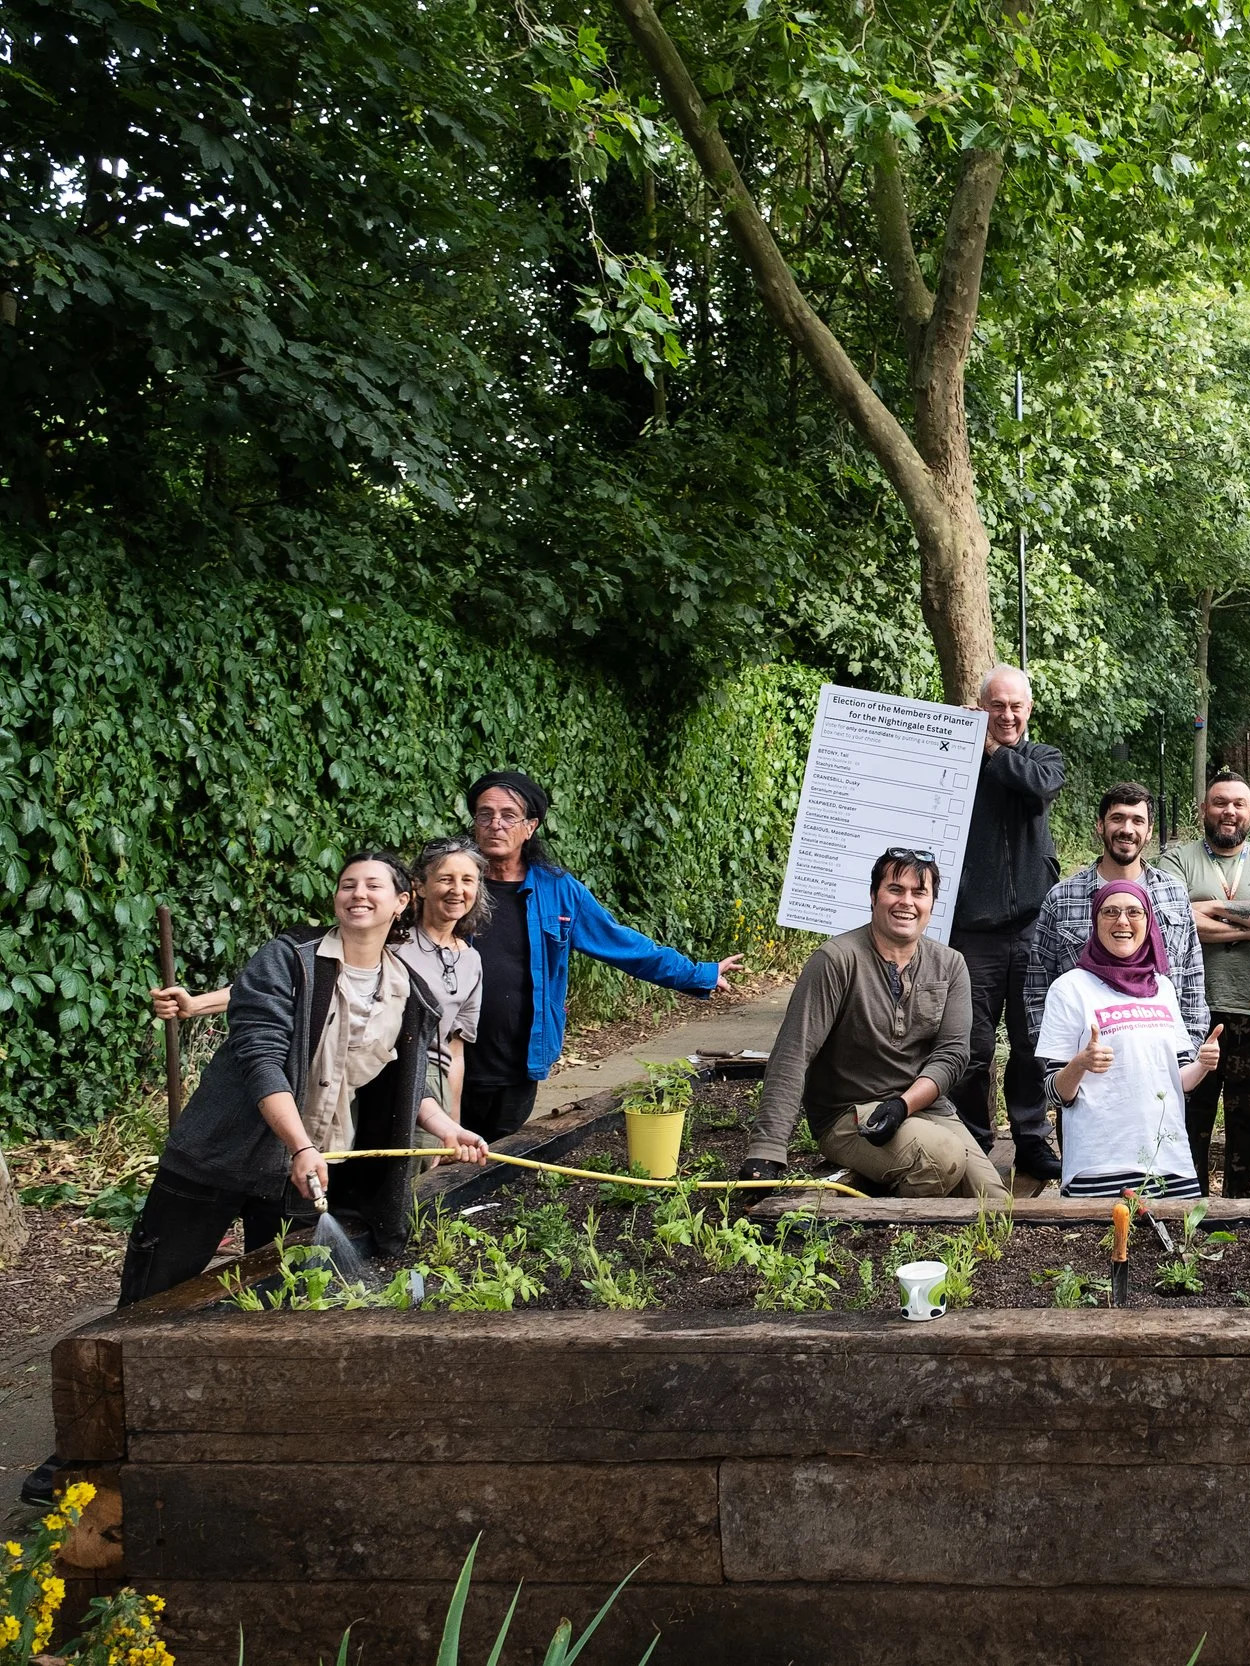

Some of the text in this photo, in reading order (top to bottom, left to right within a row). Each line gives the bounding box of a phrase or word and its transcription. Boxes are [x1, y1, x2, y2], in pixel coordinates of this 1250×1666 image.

[833, 696, 866, 708] Election
[878, 704, 891, 712] the
[893, 706, 930, 719] Members
[944, 715, 974, 727] Planter
[849, 710, 952, 735] for the Nightingale Estate
[869, 730, 894, 738] candidate
[1100, 1005, 1171, 1023] Possible.
